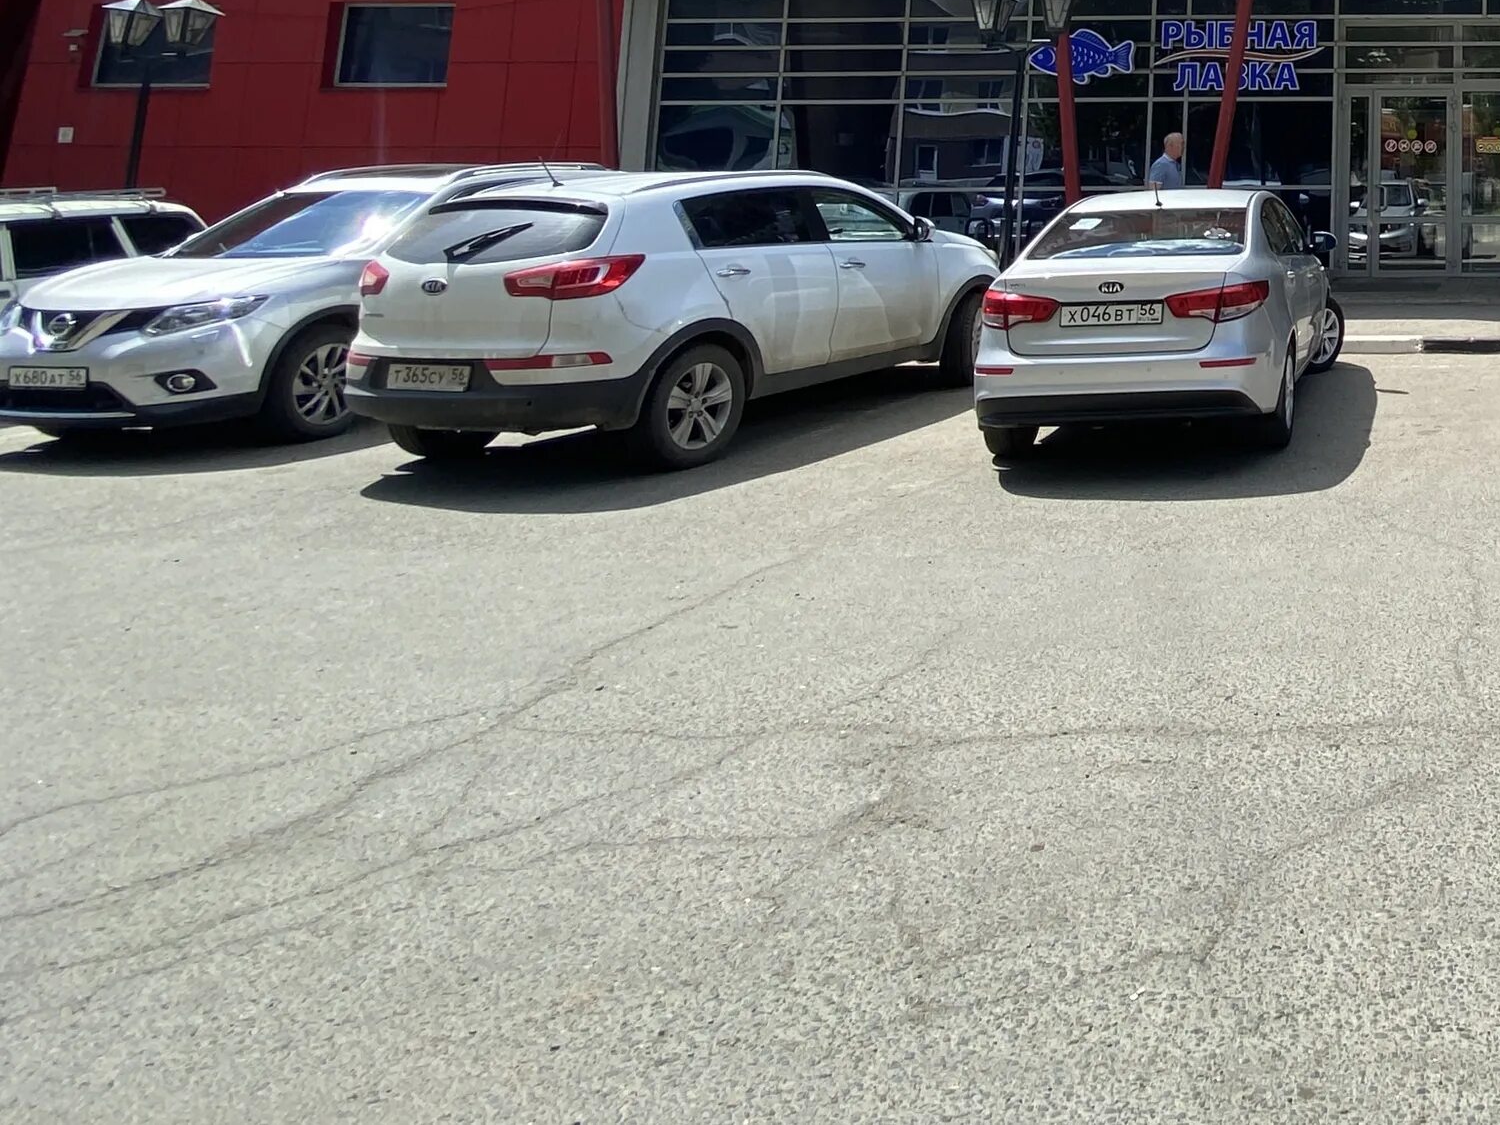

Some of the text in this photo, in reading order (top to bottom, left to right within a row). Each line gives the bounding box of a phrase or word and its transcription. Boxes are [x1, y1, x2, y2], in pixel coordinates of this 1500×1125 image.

[1161, 20, 1317, 49] РЫБНАЯ
[1100, 282, 1122, 293] KIA
[1139, 304, 1156, 316] 56
[451, 368, 465, 381] 56
